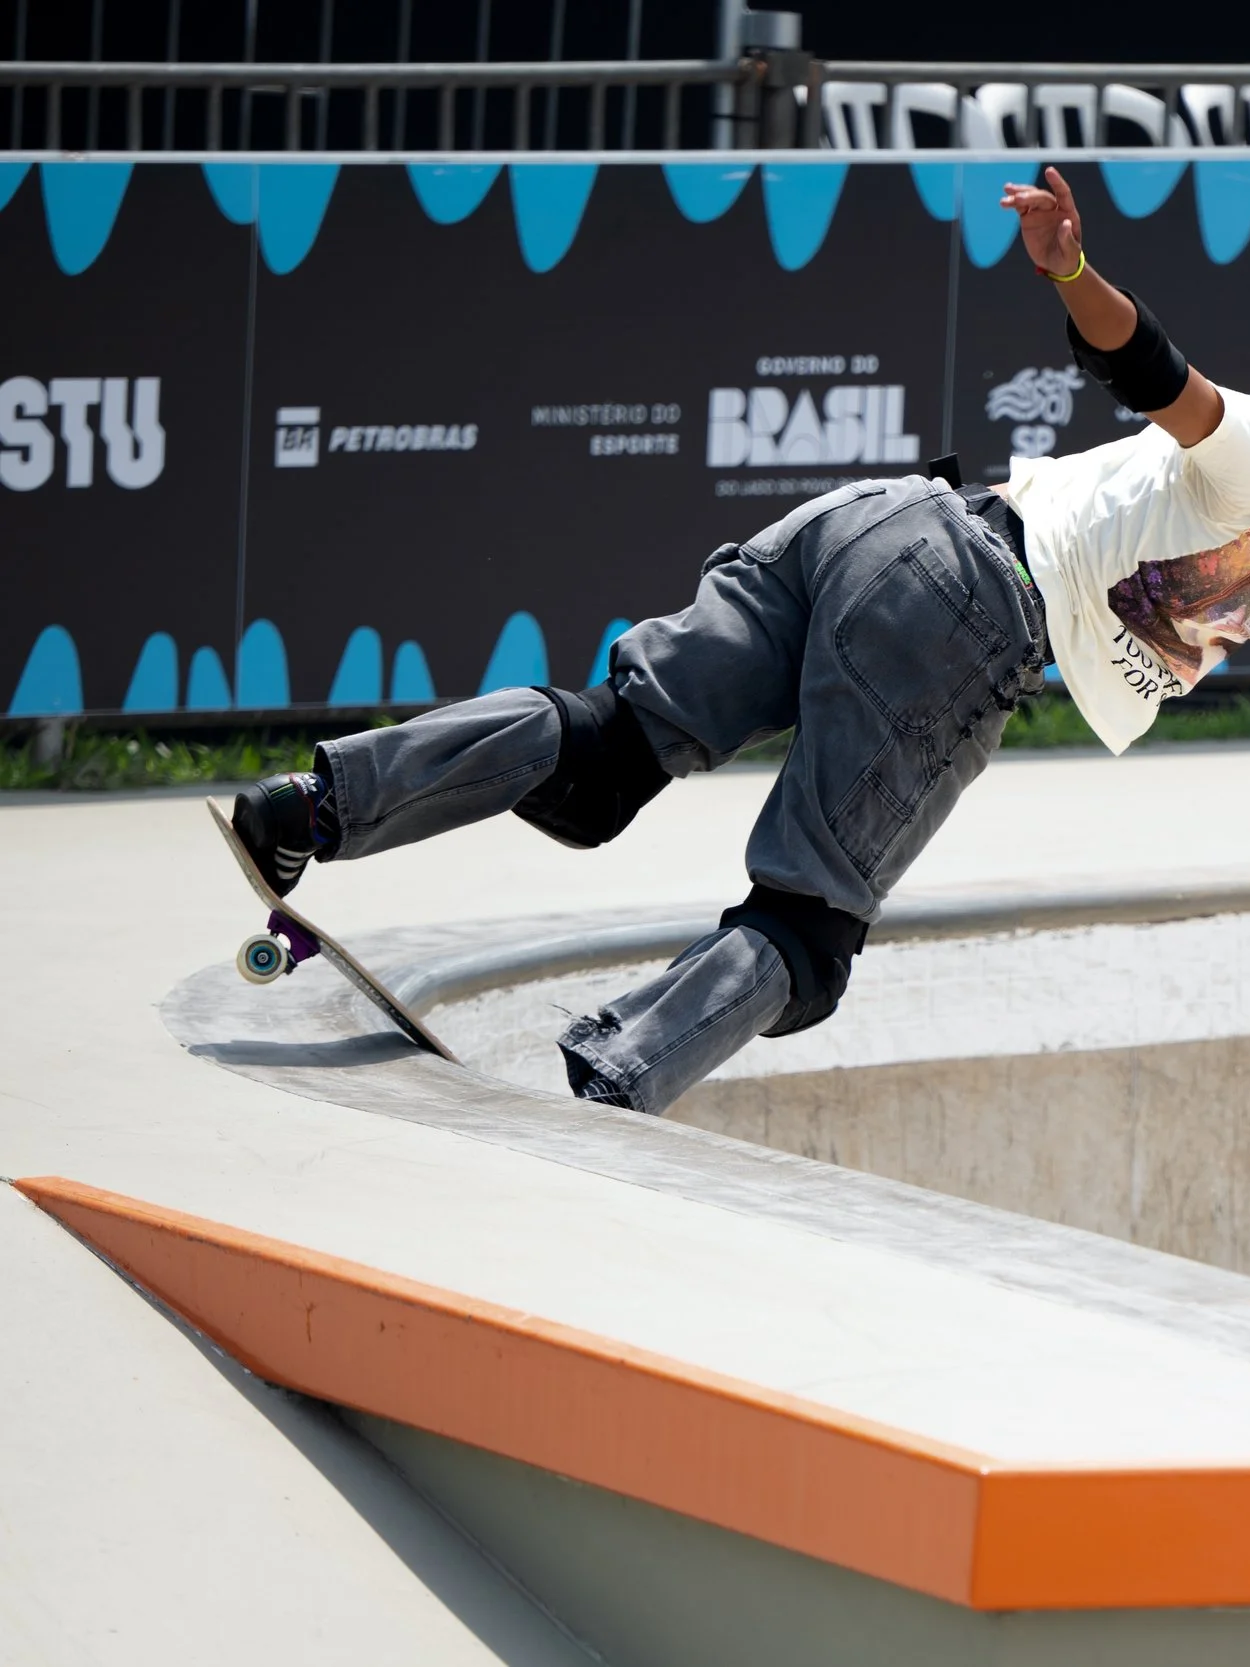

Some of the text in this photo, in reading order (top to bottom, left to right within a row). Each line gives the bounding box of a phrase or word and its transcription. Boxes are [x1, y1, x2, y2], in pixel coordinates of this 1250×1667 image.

[756, 354, 879, 376] GOVERNO DO
[651, 403, 681, 425] DO
[706, 384, 920, 467] BRASIL
[0, 376, 165, 491] STU
[328, 424, 478, 452] PETROBRAS
[590, 433, 680, 455] ESPORTE
[1110, 657, 1158, 700] FOR
